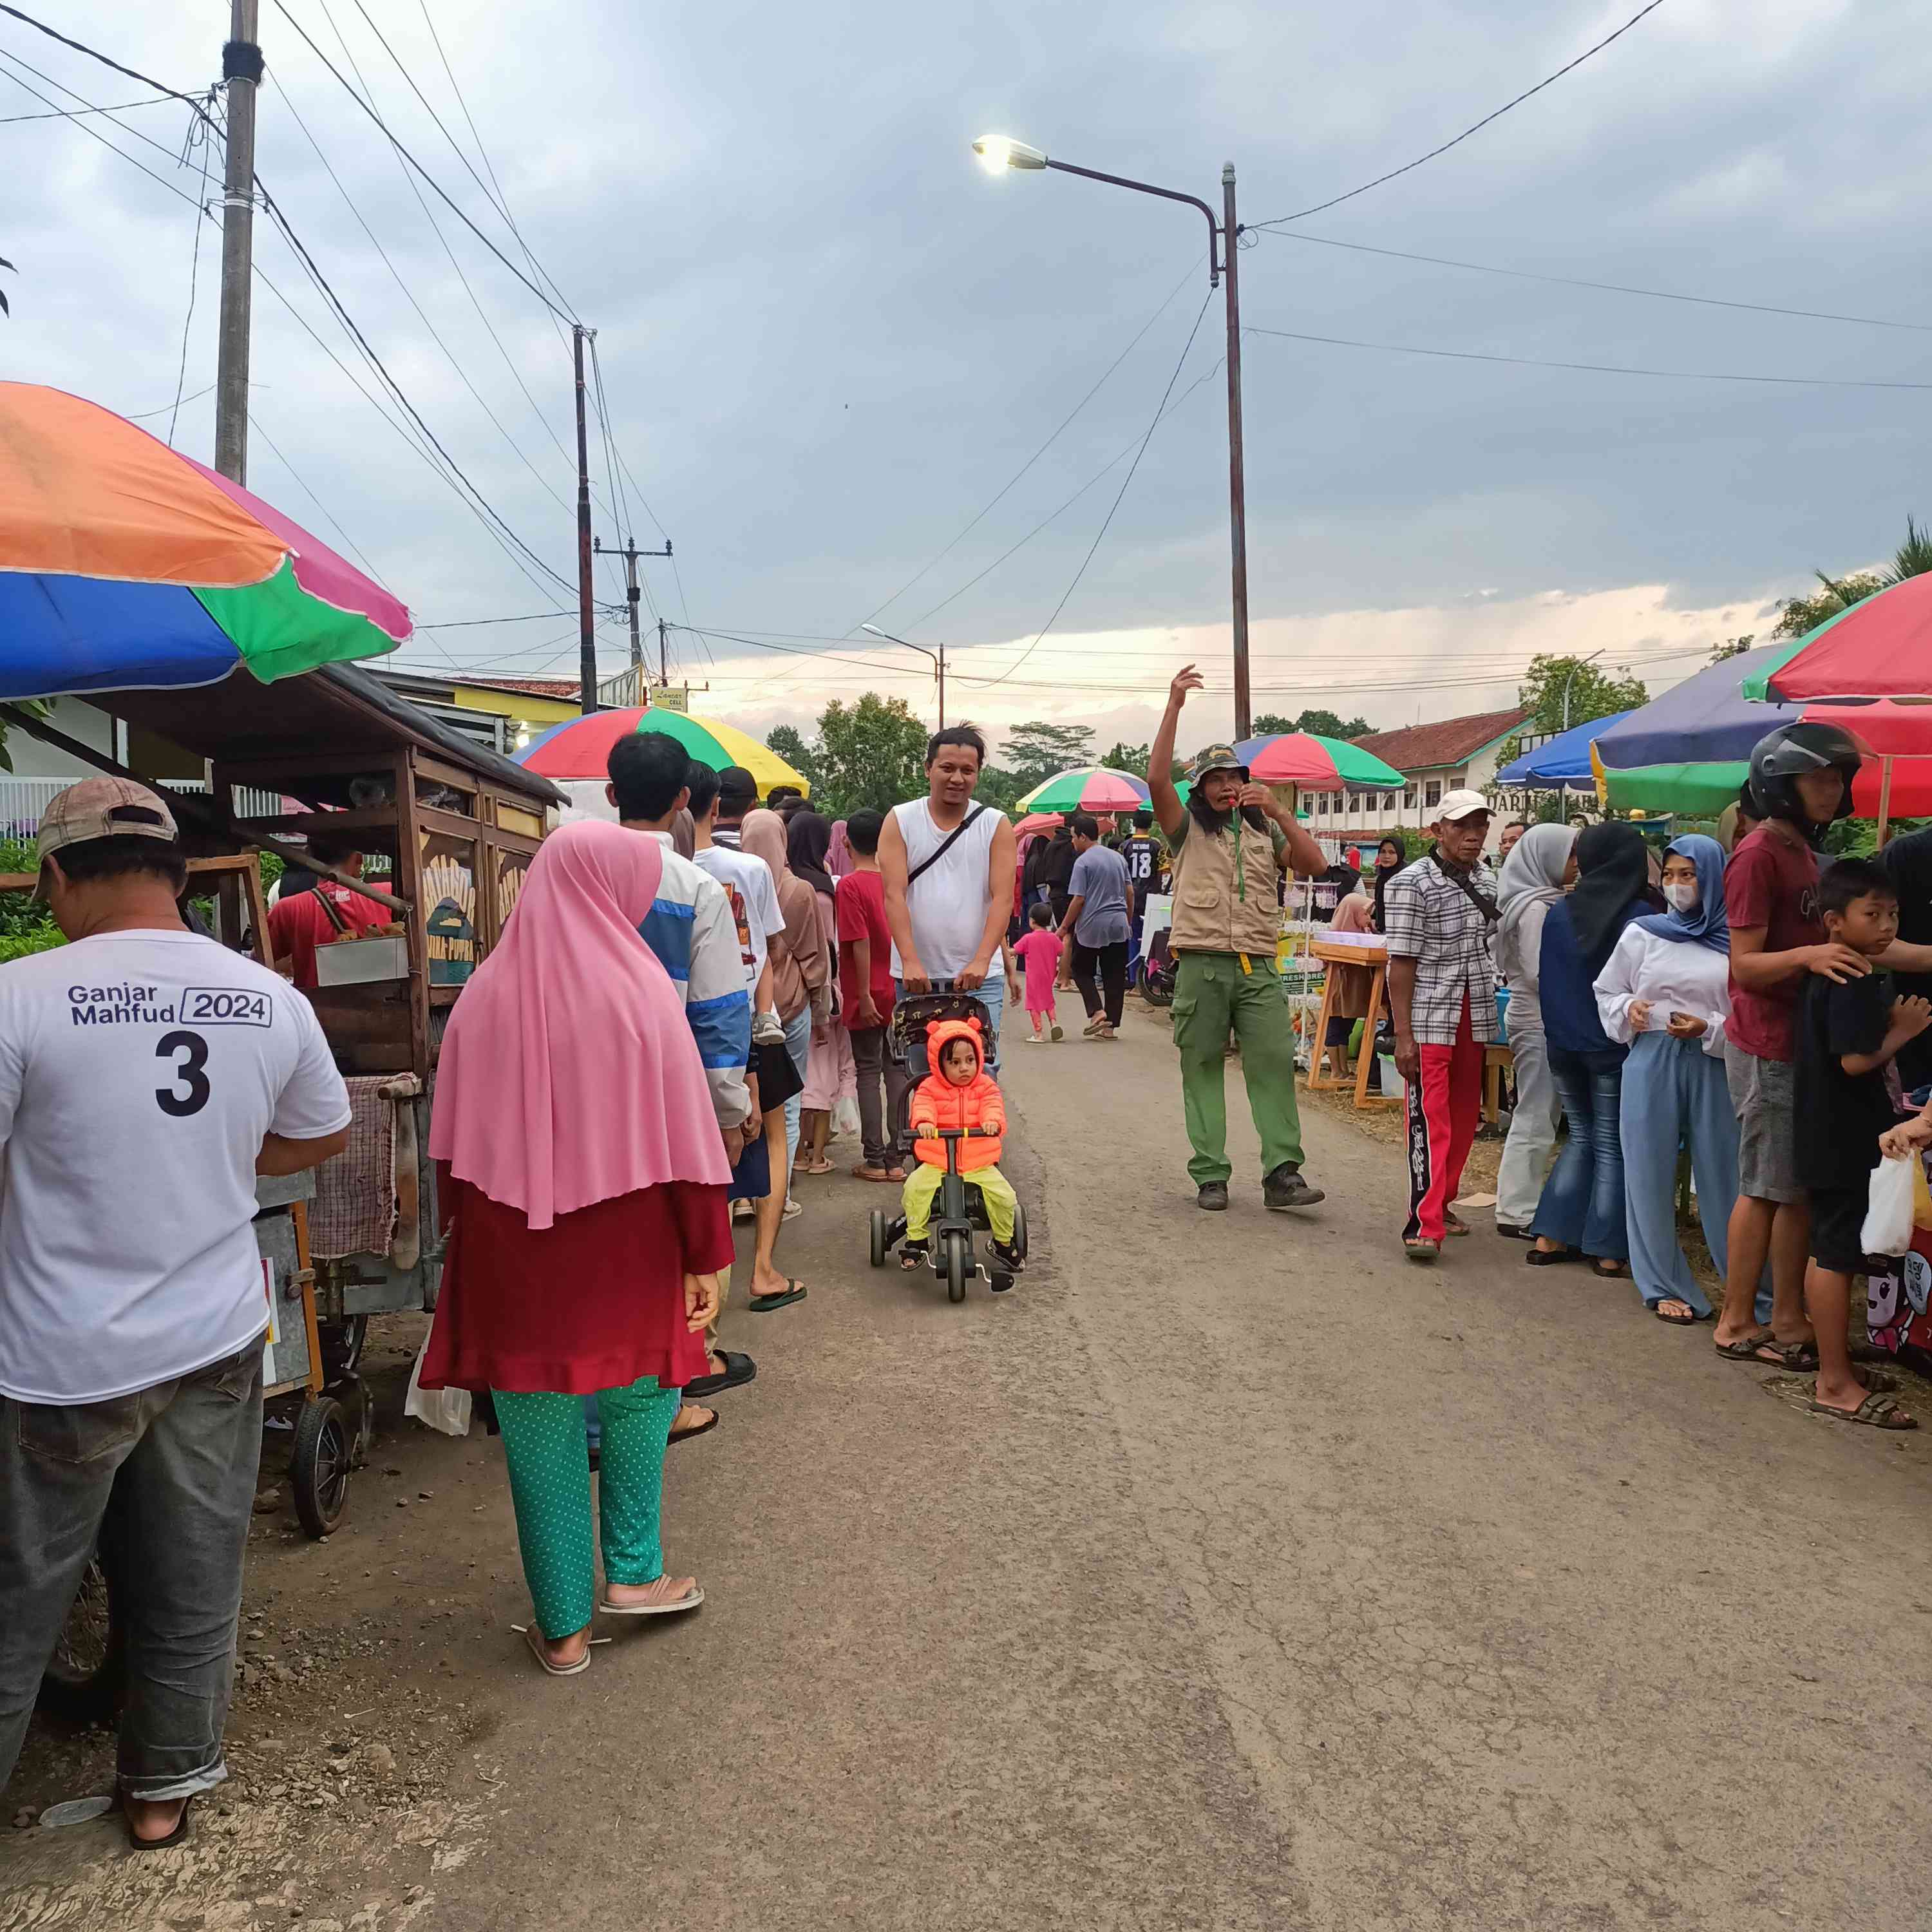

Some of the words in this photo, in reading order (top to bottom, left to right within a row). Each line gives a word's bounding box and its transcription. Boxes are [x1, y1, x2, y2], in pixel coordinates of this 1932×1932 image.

[1129, 852, 1151, 878] 18
[68, 982, 158, 1006] Ganjar
[71, 1003, 175, 1025] Mahfud
[193, 994, 265, 1019] 2024
[155, 1030, 210, 1117] 3
